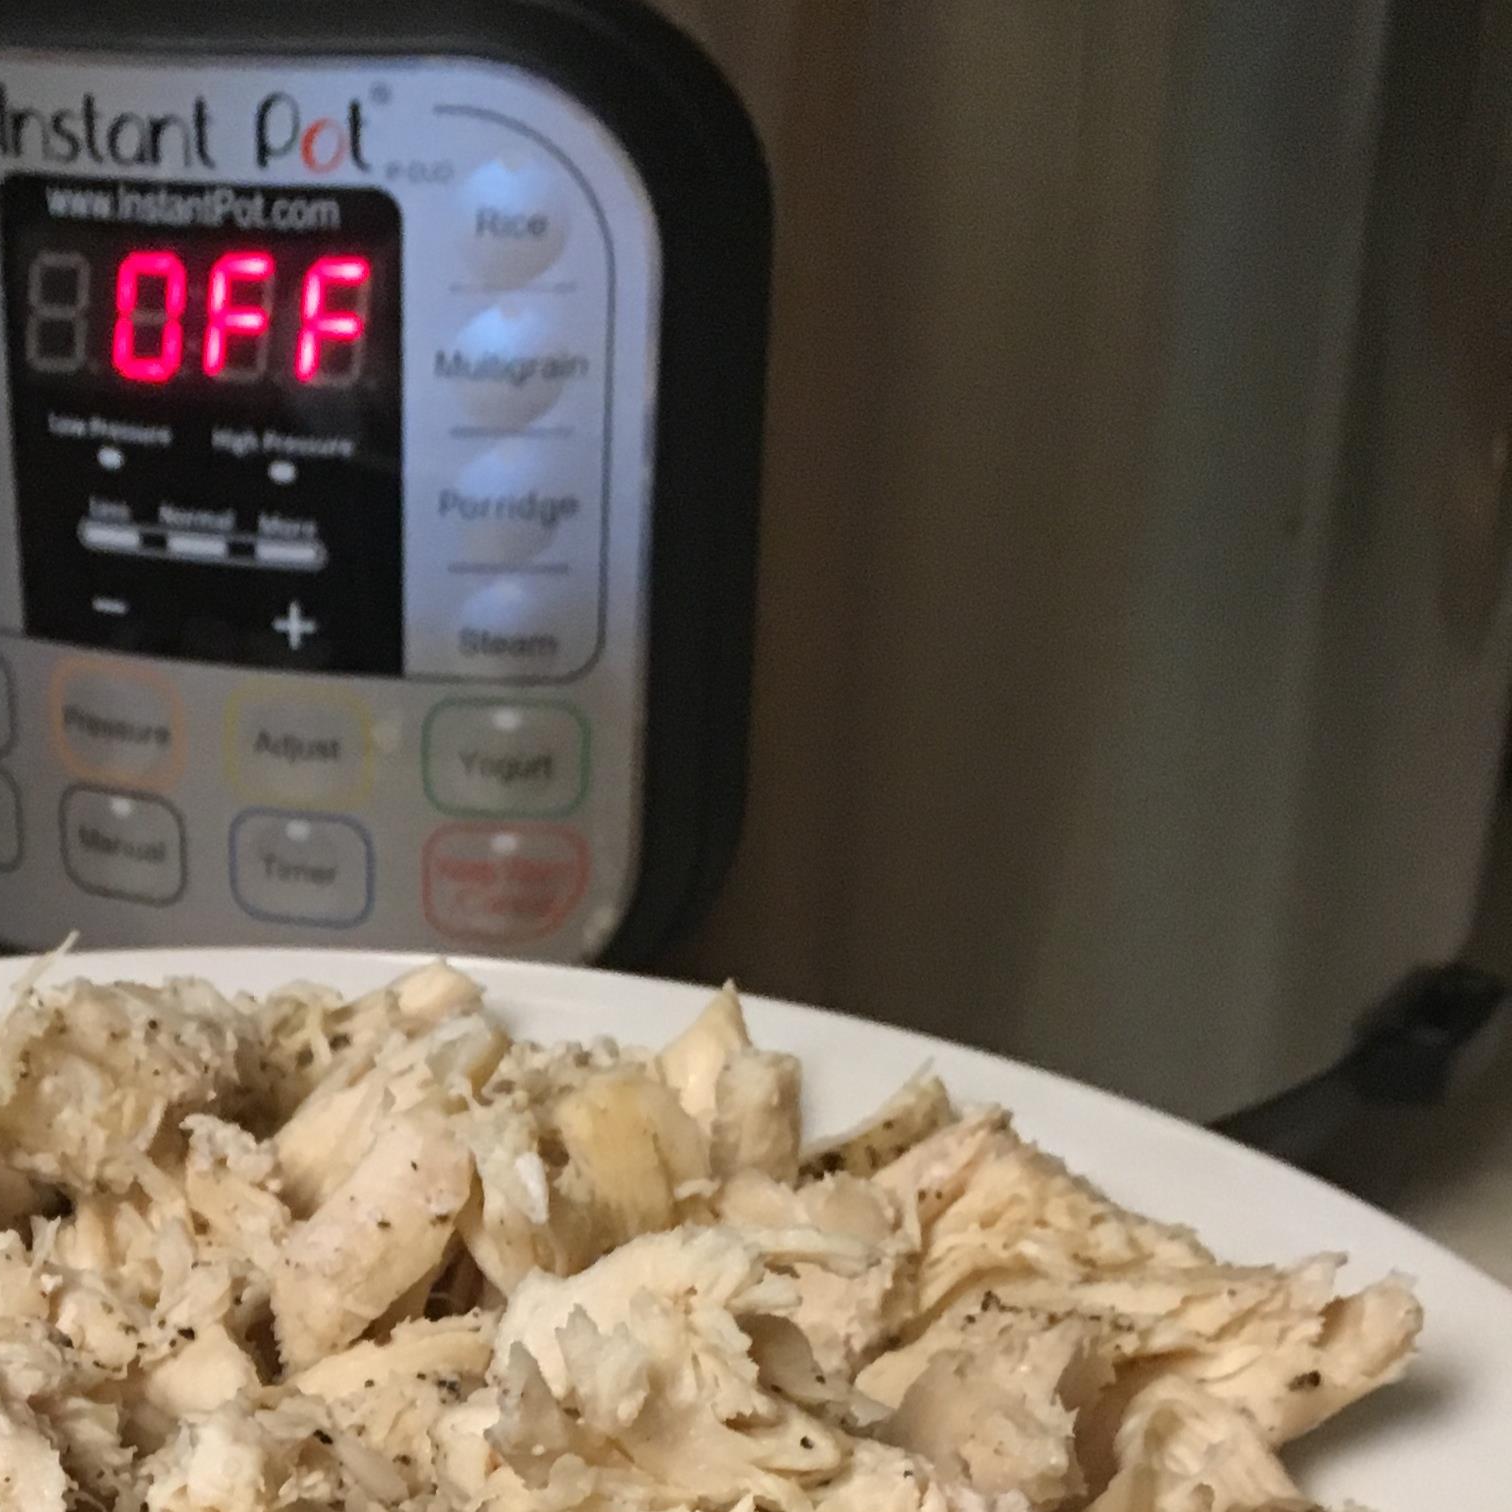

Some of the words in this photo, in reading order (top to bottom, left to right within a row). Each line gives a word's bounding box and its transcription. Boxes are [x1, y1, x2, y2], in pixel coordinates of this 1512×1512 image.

[256, 91, 372, 173] Pot
[46, 184, 342, 231] www.InstantPot.com
[112, 250, 372, 384] OFF
